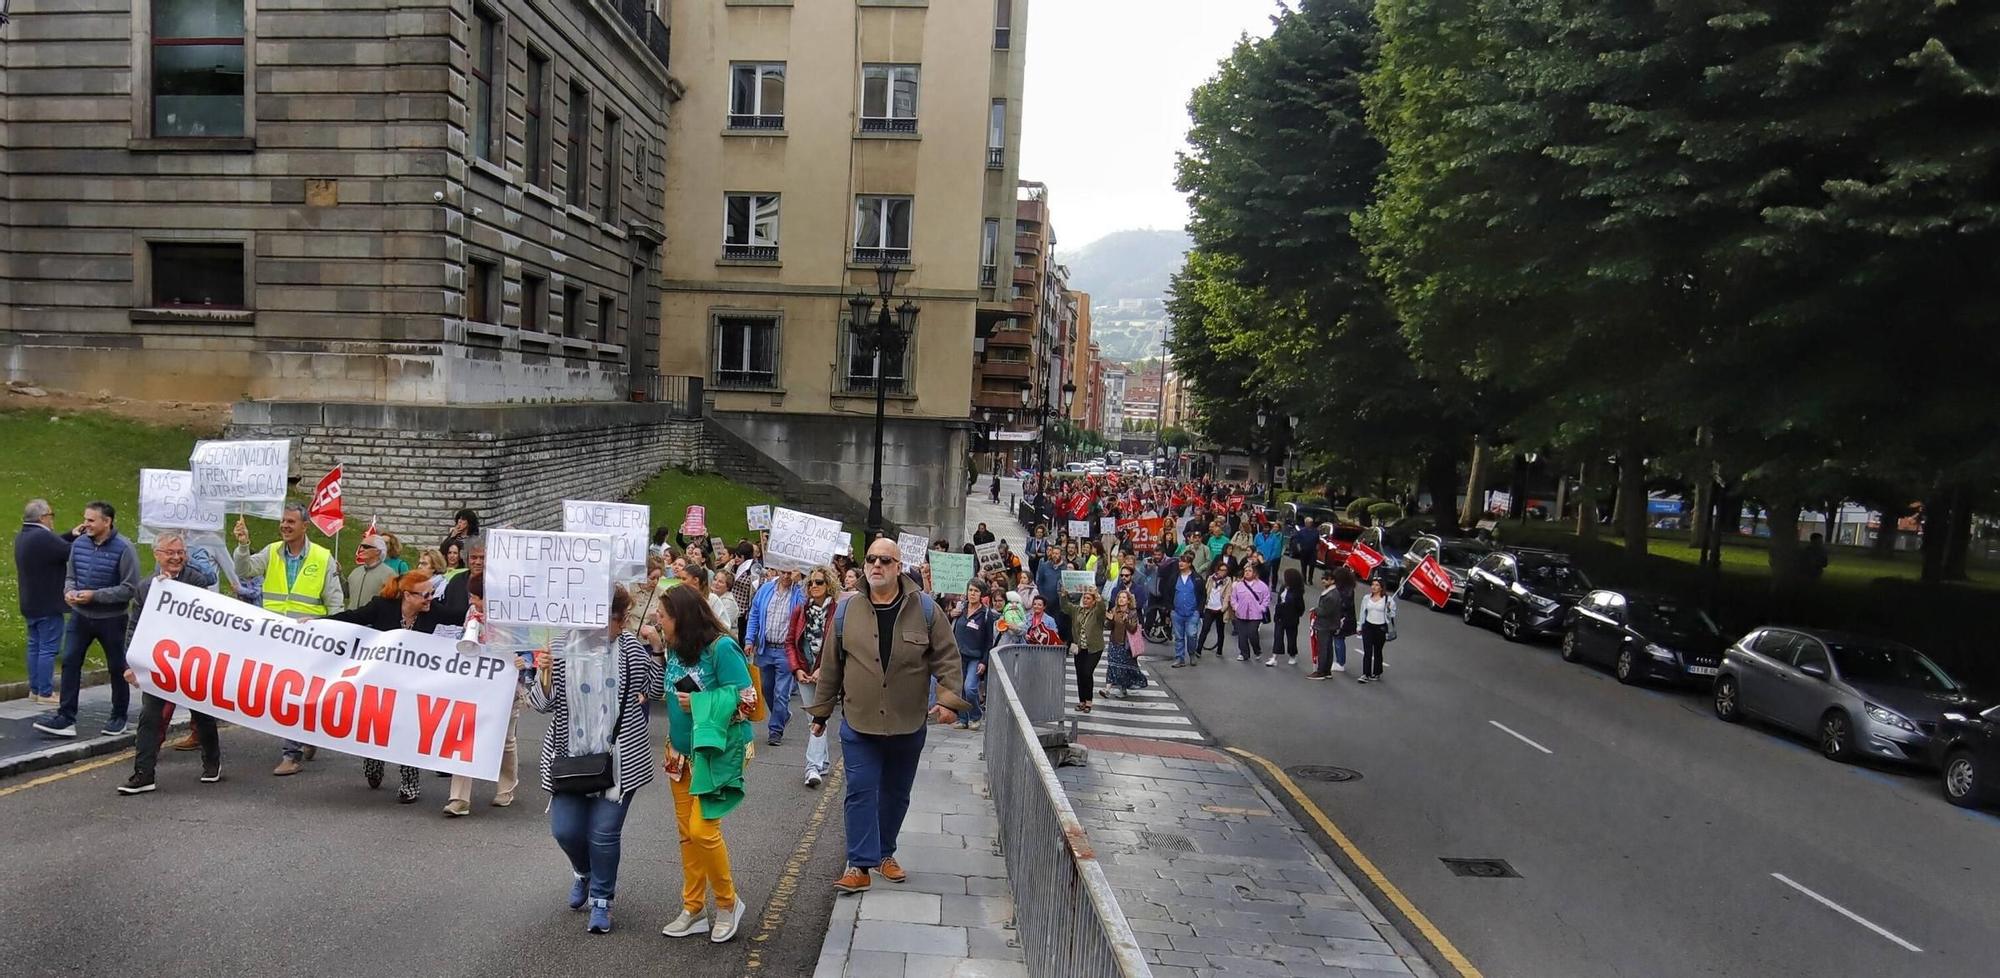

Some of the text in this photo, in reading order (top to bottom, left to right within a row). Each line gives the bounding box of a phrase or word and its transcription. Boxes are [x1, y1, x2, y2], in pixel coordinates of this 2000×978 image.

[150, 472, 181, 491] MÁS
[199, 467, 243, 483] FRENTE
[248, 473, 284, 495] CCAA
[566, 505, 649, 529] CONSEJERA
[777, 520, 789, 530] DE
[815, 527, 838, 543] AÑOS
[789, 533, 816, 548] COMO
[1132, 527, 1148, 541] 23
[493, 532, 602, 563] INTERINOS
[770, 540, 831, 565] DOCENTES
[508, 575, 536, 599] DE
[1420, 560, 1450, 593] CCOO
[488, 600, 607, 625] EN LA CALLE
[156, 590, 505, 681] Profesores Técnicos Interinos de FP
[149, 638, 478, 763] SOLUCIÓN YA
